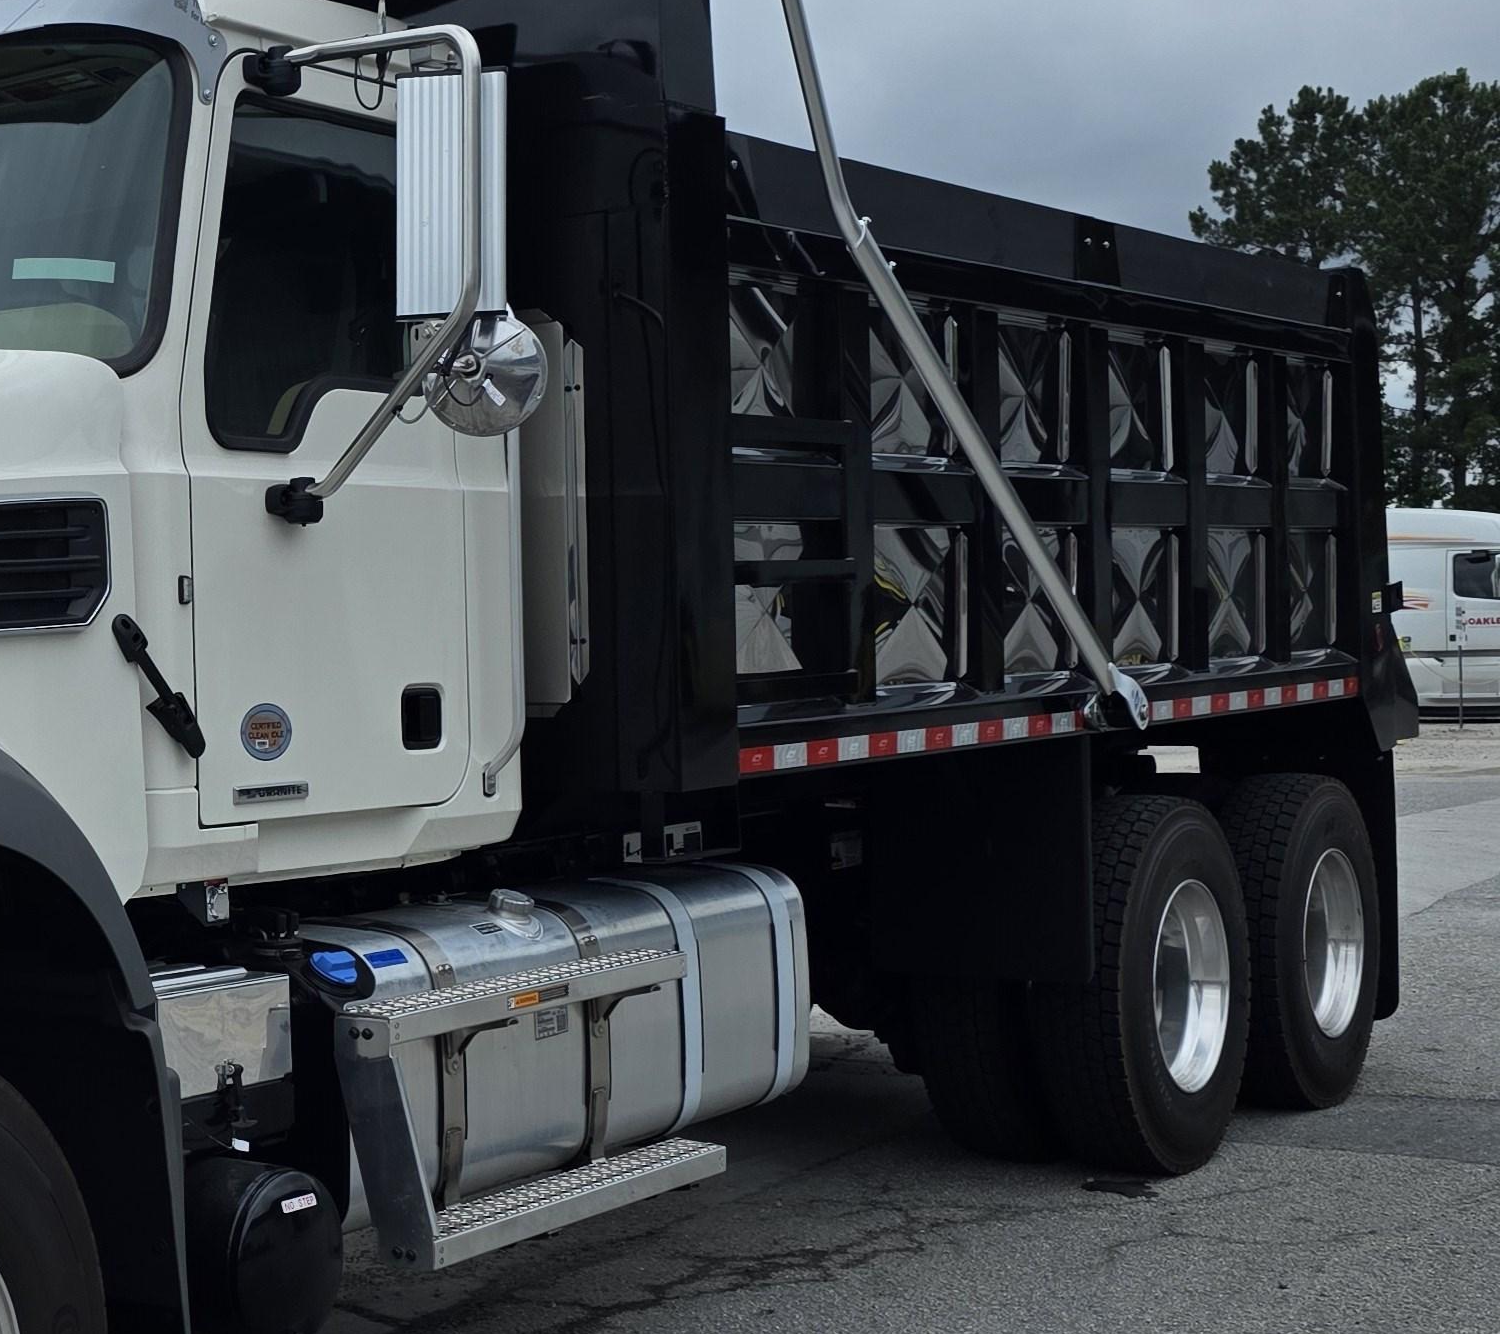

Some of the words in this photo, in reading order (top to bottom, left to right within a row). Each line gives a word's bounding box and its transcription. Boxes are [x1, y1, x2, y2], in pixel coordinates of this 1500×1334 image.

[250, 721, 282, 730] CERTIFIED
[248, 731, 269, 740] CLEAN
[271, 730, 285, 739] IDLE
[259, 785, 303, 798] GRANITE
[284, 1201, 294, 1212] NO
[298, 1195, 314, 1208] STEP
